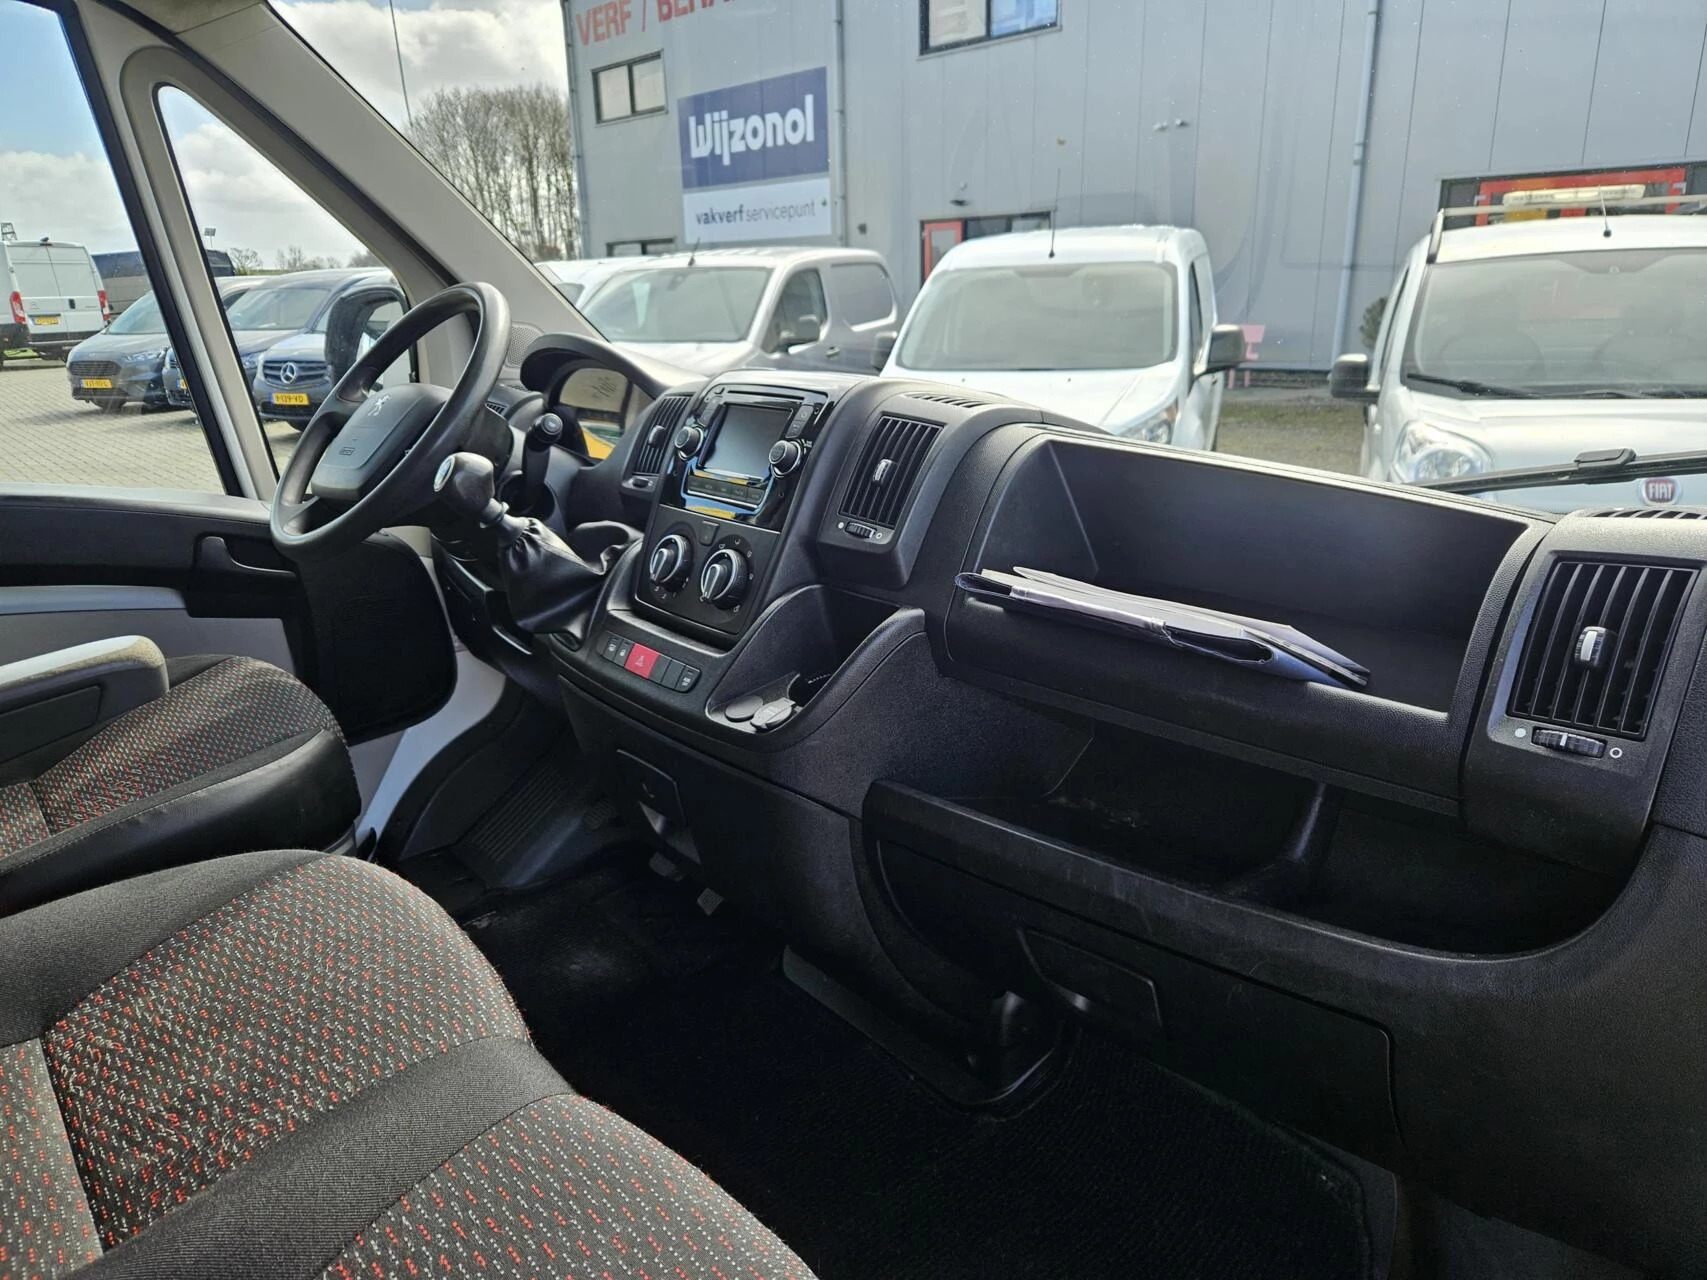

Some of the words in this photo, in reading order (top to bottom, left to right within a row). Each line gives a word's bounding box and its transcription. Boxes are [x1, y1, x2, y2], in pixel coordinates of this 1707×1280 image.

[576, 0, 632, 46] VERF
[689, 94, 814, 166] Wijzonol
[1648, 482, 1673, 499] FIAT
